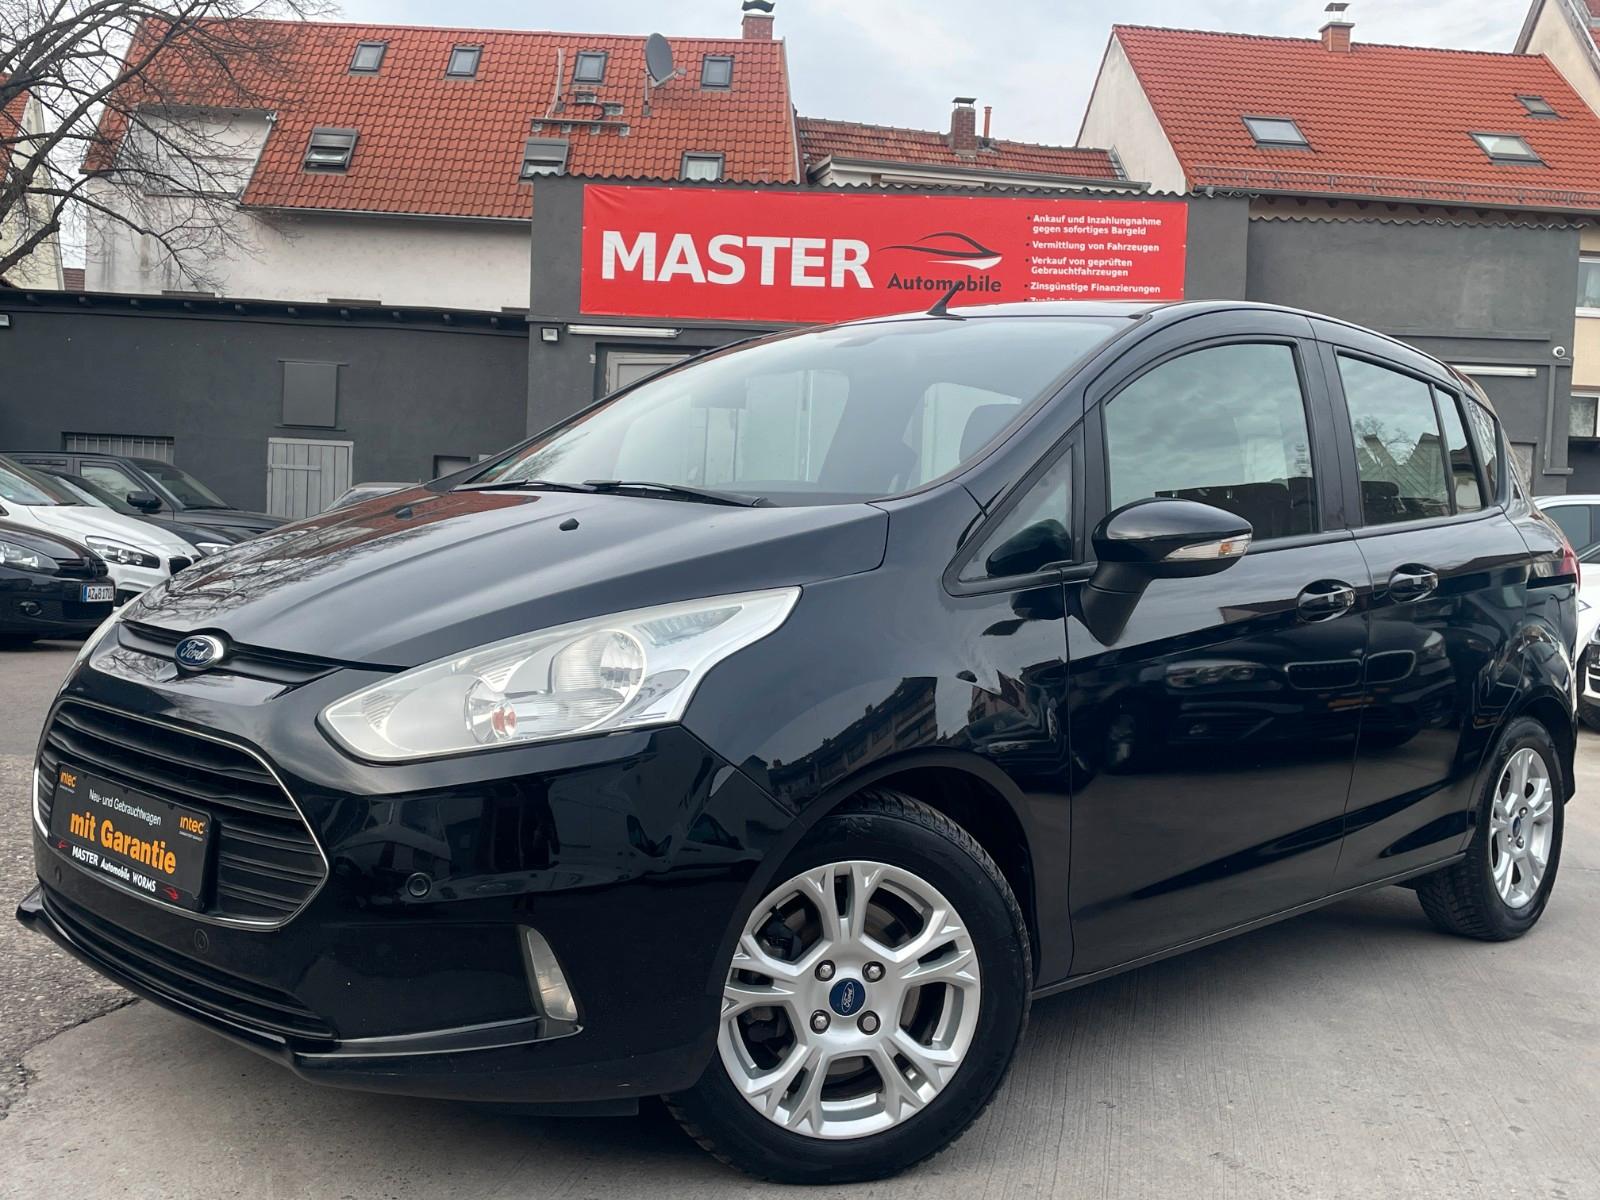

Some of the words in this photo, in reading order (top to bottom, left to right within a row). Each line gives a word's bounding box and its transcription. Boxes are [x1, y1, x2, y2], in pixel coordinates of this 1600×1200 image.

[1033, 214, 1066, 223] Ankauf
[1067, 215, 1085, 223] und
[1087, 215, 1162, 226] Inzahlungnahme
[1032, 225, 1061, 234] gegen
[1063, 225, 1109, 235] sofortiges
[1111, 226, 1147, 236] Bargeld
[1032, 240, 1086, 252] Vermittlung
[1107, 242, 1160, 253] Fahrzeugen
[601, 230, 874, 289] MASTER
[1031, 256, 1067, 265] Verkauf
[1087, 257, 1133, 268] geprüften
[1031, 266, 1129, 278] Gebrauchtfahrzeugen
[887, 272, 1002, 292] Automobile
[1029, 281, 1089, 293] Zinsgünstige
[1090, 282, 1161, 295] Finanzierungen
[180, 639, 209, 661] Ford
[102, 796, 114, 808] und
[113, 798, 162, 826] Gebrauchtwagen
[179, 816, 206, 835] intec
[70, 811, 96, 842] mit
[101, 819, 177, 875] Garantie
[71, 845, 99, 866] MASTER
[100, 857, 131, 880] Automobile
[132, 871, 157, 893] WORMS
